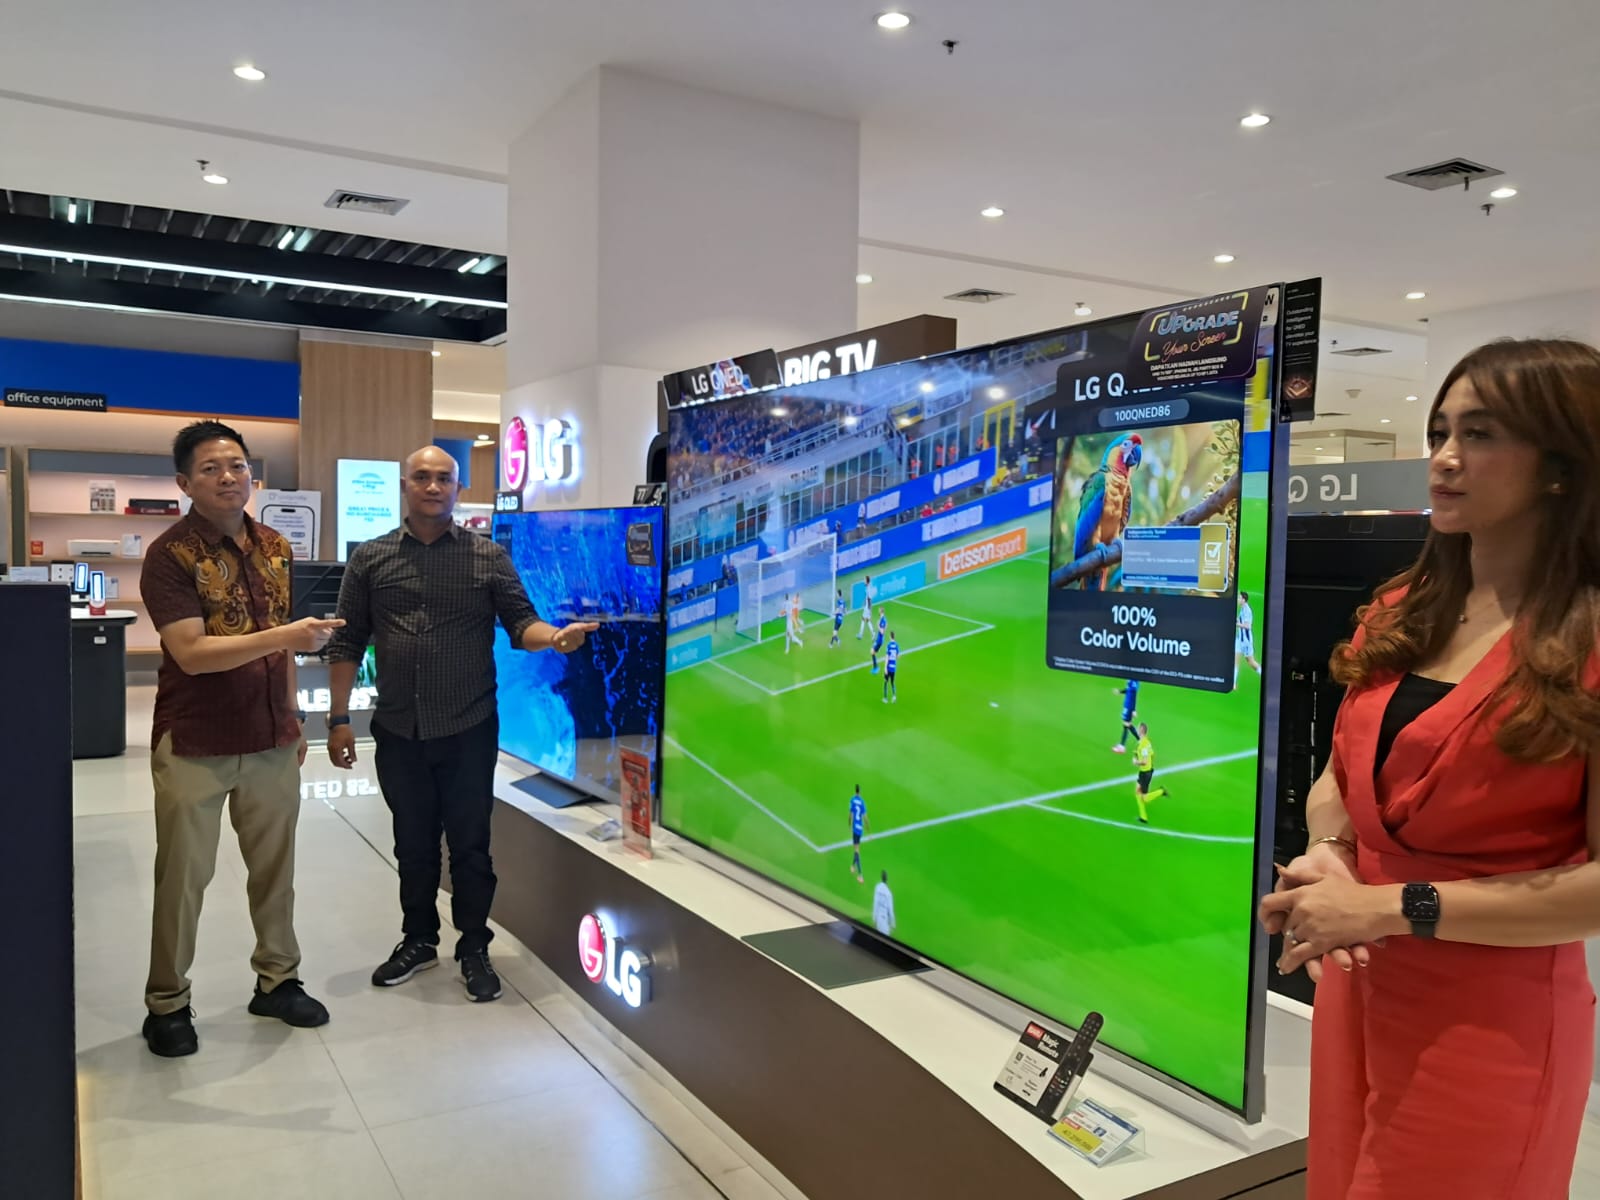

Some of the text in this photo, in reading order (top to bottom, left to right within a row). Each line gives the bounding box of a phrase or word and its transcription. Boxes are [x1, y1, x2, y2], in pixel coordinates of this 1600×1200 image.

[1158, 311, 1240, 335] UPGRADE
[835, 338, 878, 376] TV
[691, 366, 744, 395] LG QNED
[1075, 376, 1101, 402] LG
[7, 392, 104, 408] office equipment
[1115, 405, 1171, 422] 100QNED86
[529, 417, 569, 483] LG
[1111, 605, 1157, 628] 100%
[1080, 627, 1191, 657] Color Volume
[606, 936, 642, 1008] LG
